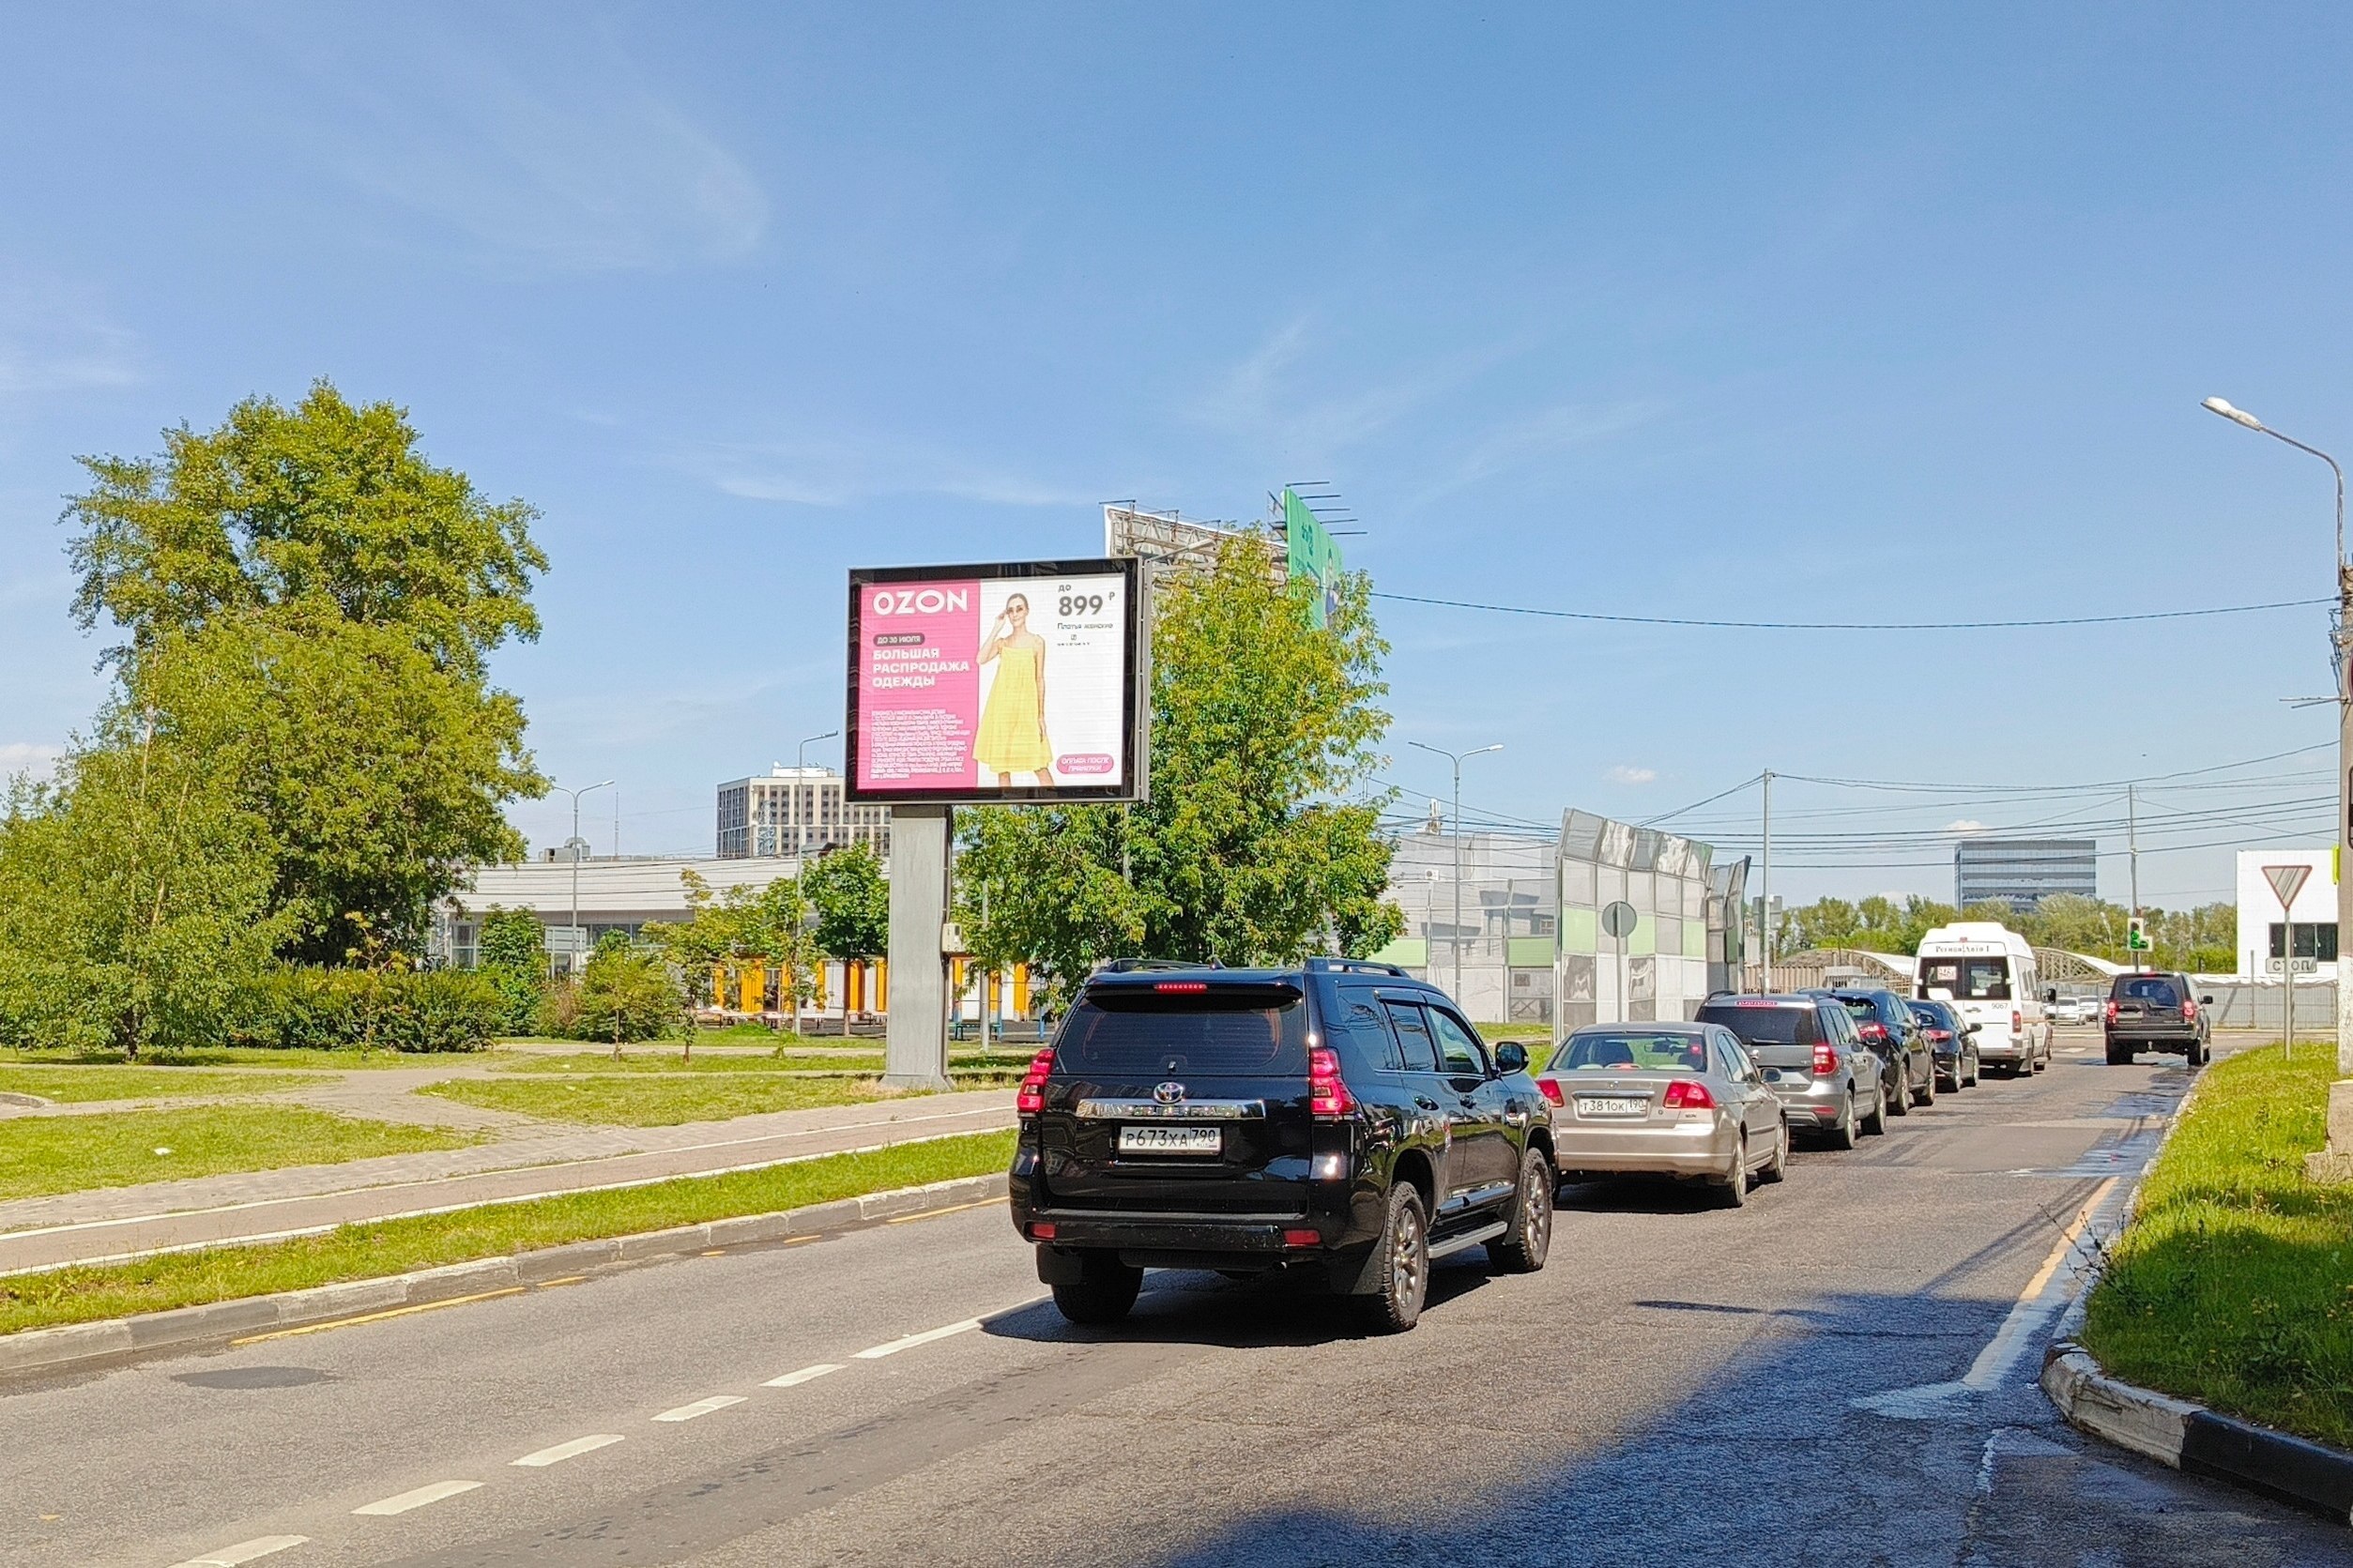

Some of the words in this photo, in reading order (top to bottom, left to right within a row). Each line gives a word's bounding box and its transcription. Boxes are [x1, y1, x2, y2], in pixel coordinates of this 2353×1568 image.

[873, 588, 968, 616] OZON
[1059, 595, 1103, 617] 899
[873, 647, 940, 661] БОЛЬШАЯ
[873, 661, 970, 675] РАСПРОДАЖА
[872, 676, 936, 689] ОДЕЖДЫ
[2272, 960, 2310, 971] СОП
[1191, 1129, 1216, 1143] 790
